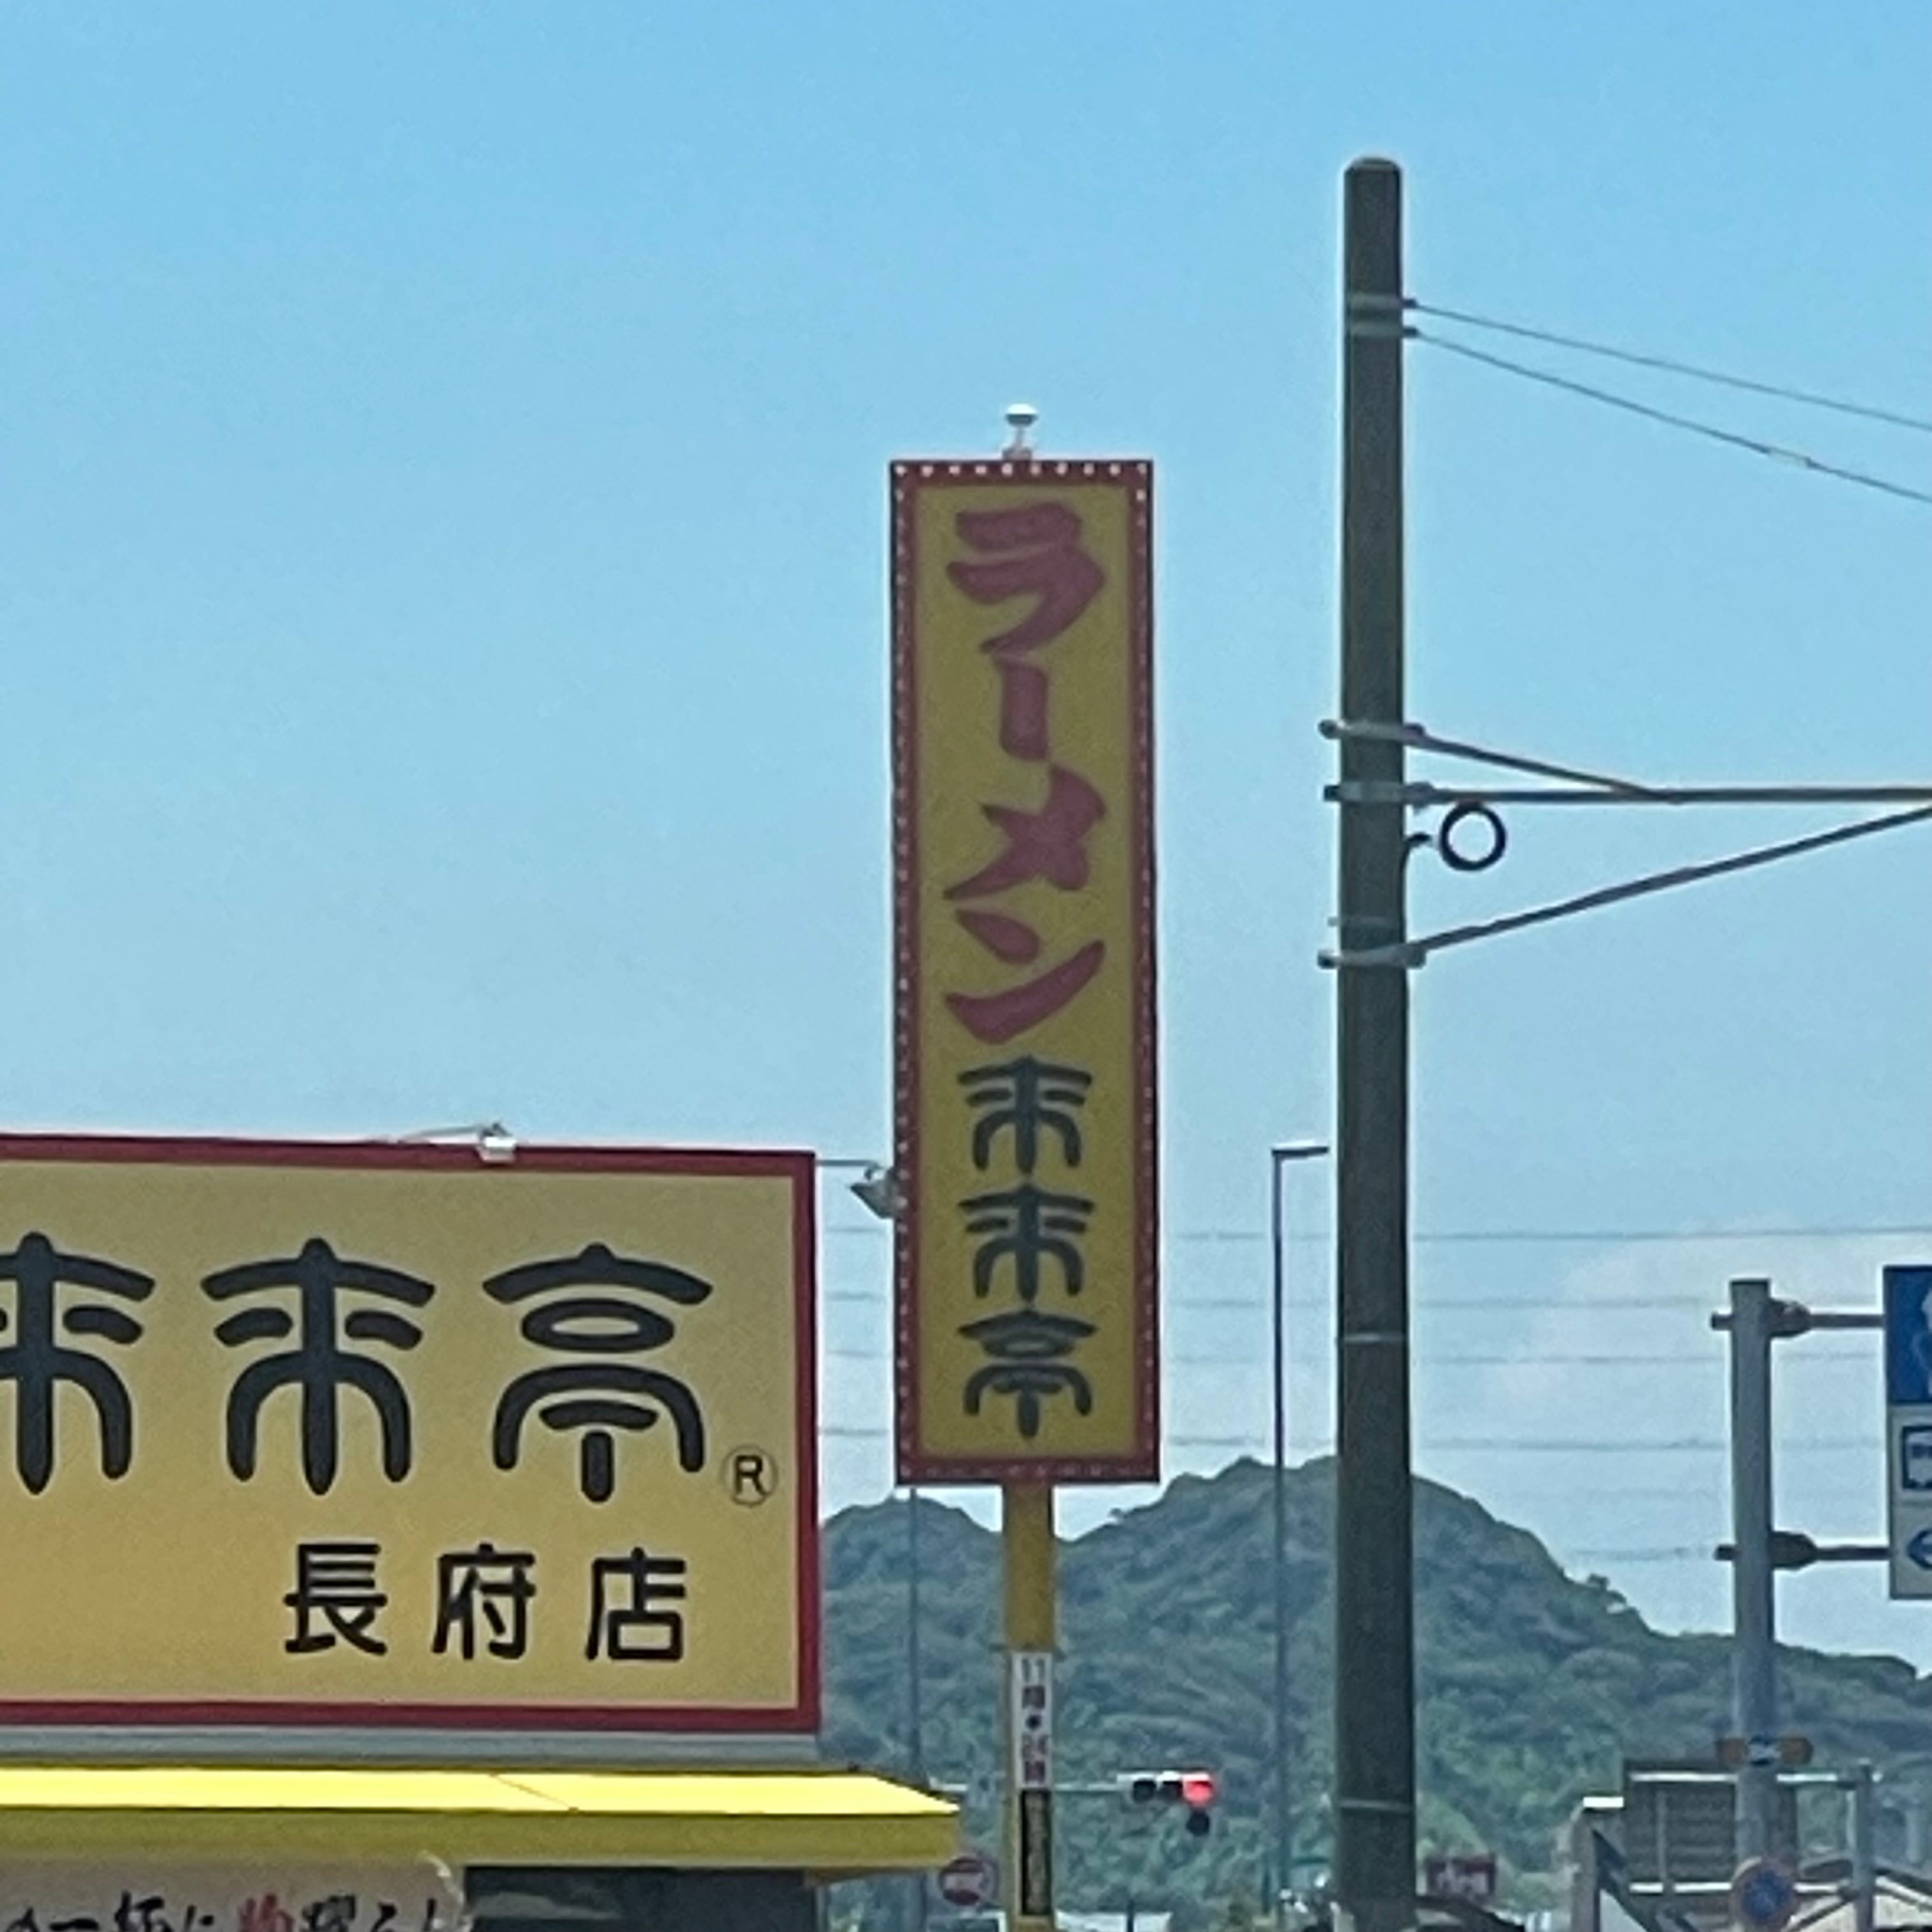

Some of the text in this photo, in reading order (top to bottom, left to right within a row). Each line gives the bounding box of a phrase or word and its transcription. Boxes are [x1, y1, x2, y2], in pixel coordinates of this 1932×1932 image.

[944, 503, 1106, 1045] ラーメン
[284, 1542, 687, 1661] 長府店
